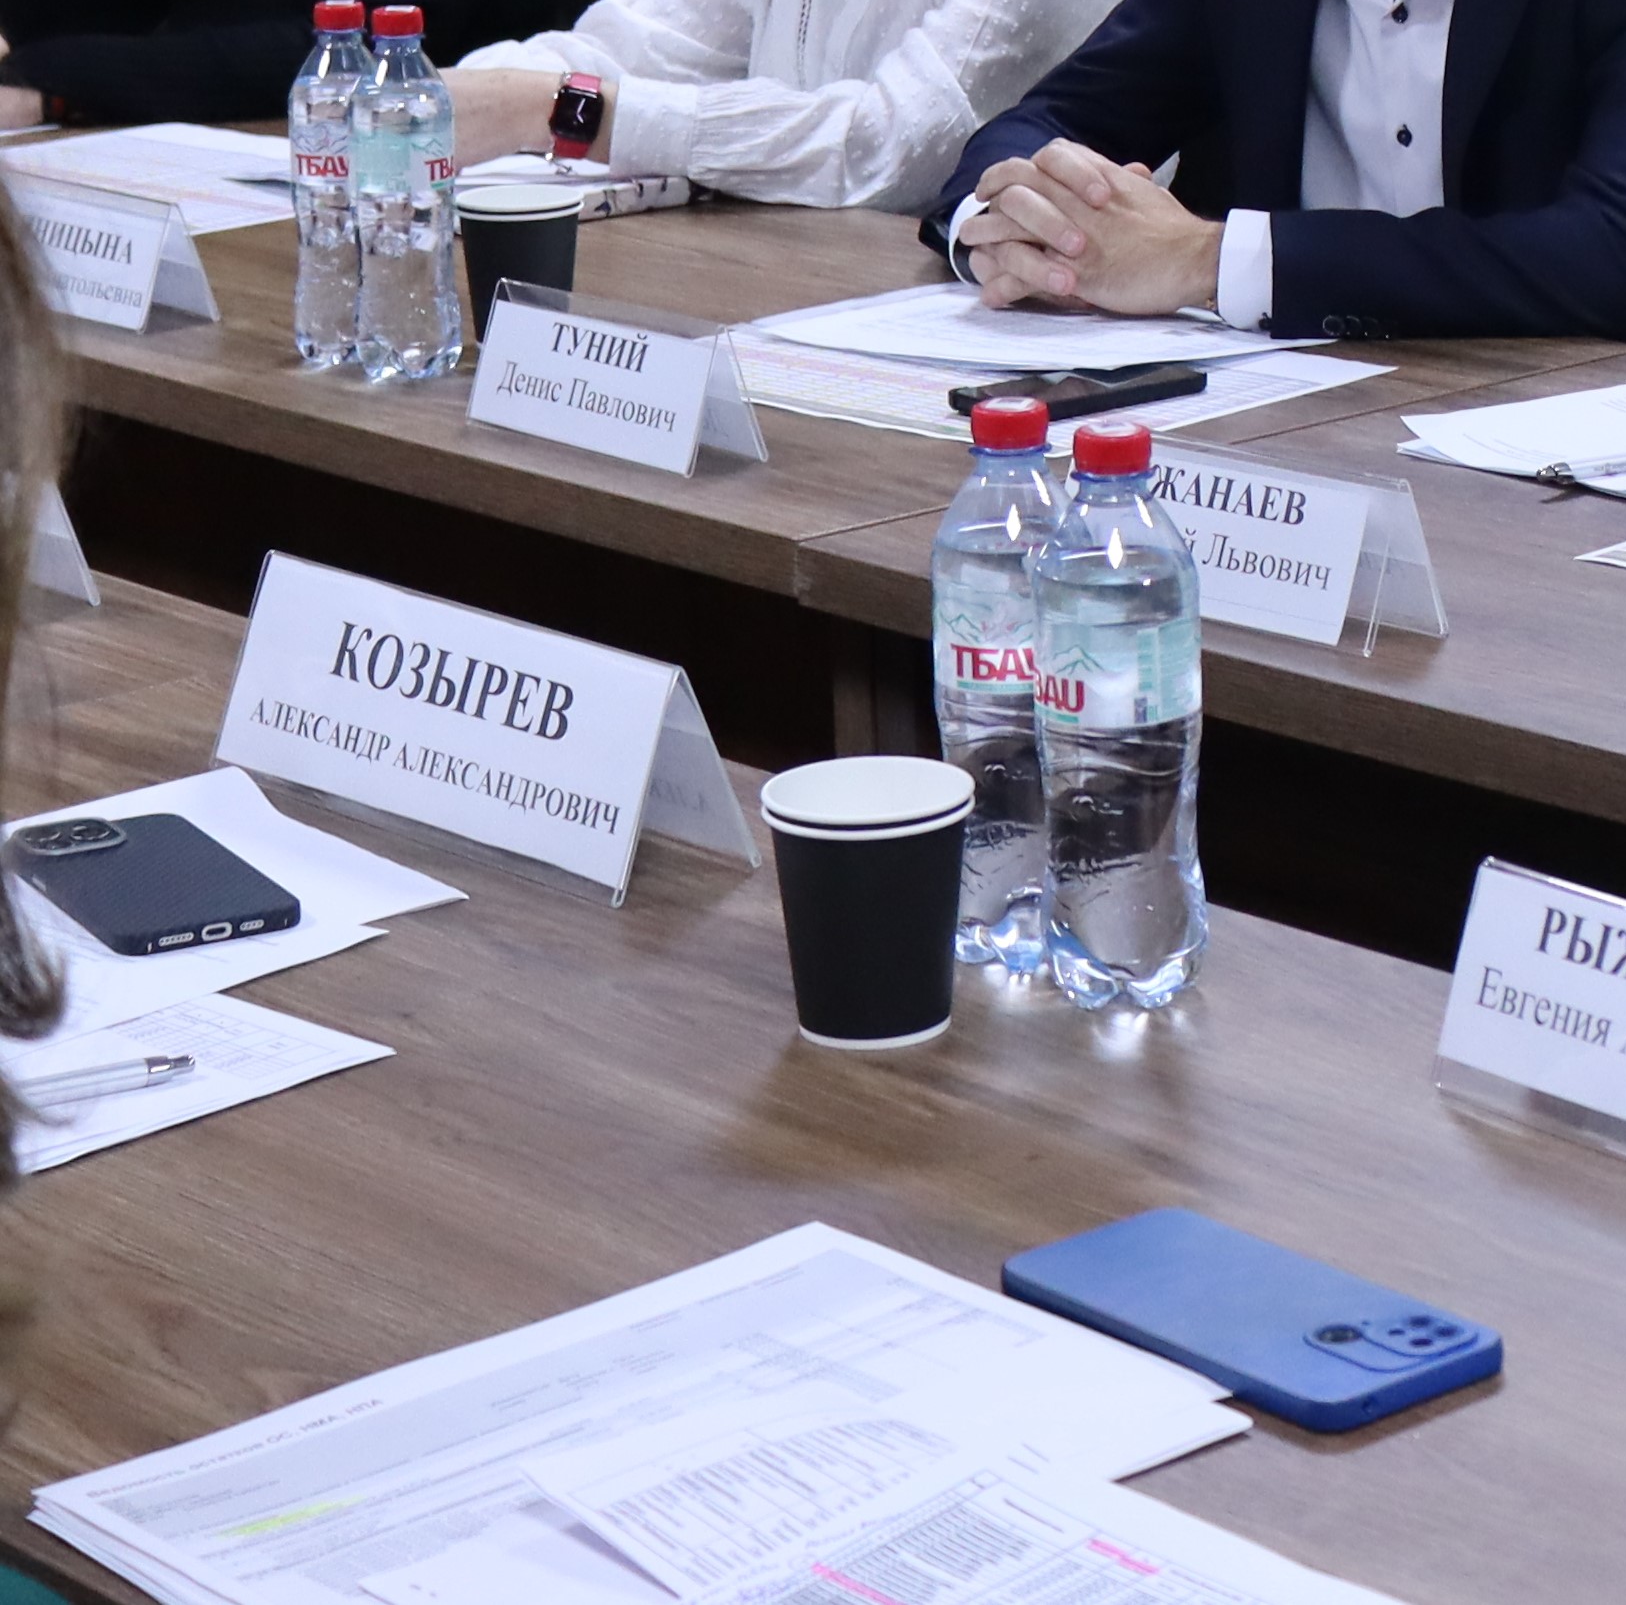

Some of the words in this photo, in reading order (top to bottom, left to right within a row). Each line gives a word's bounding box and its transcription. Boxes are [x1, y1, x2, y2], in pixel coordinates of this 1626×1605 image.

[551, 321, 650, 373] ТУНИЙ
[496, 360, 563, 402] Денис
[566, 377, 677, 433] Павлович
[1150, 464, 1308, 526] ЖАНАЕВ
[1202, 533, 1333, 591] Львович
[328, 620, 575, 742] КОЗЫРЕВ
[249, 697, 391, 763] АЛЕКСАНДР
[392, 742, 621, 836] АЛЕКСАНДРОВИЧ
[1474, 964, 1615, 1048] Евгения
